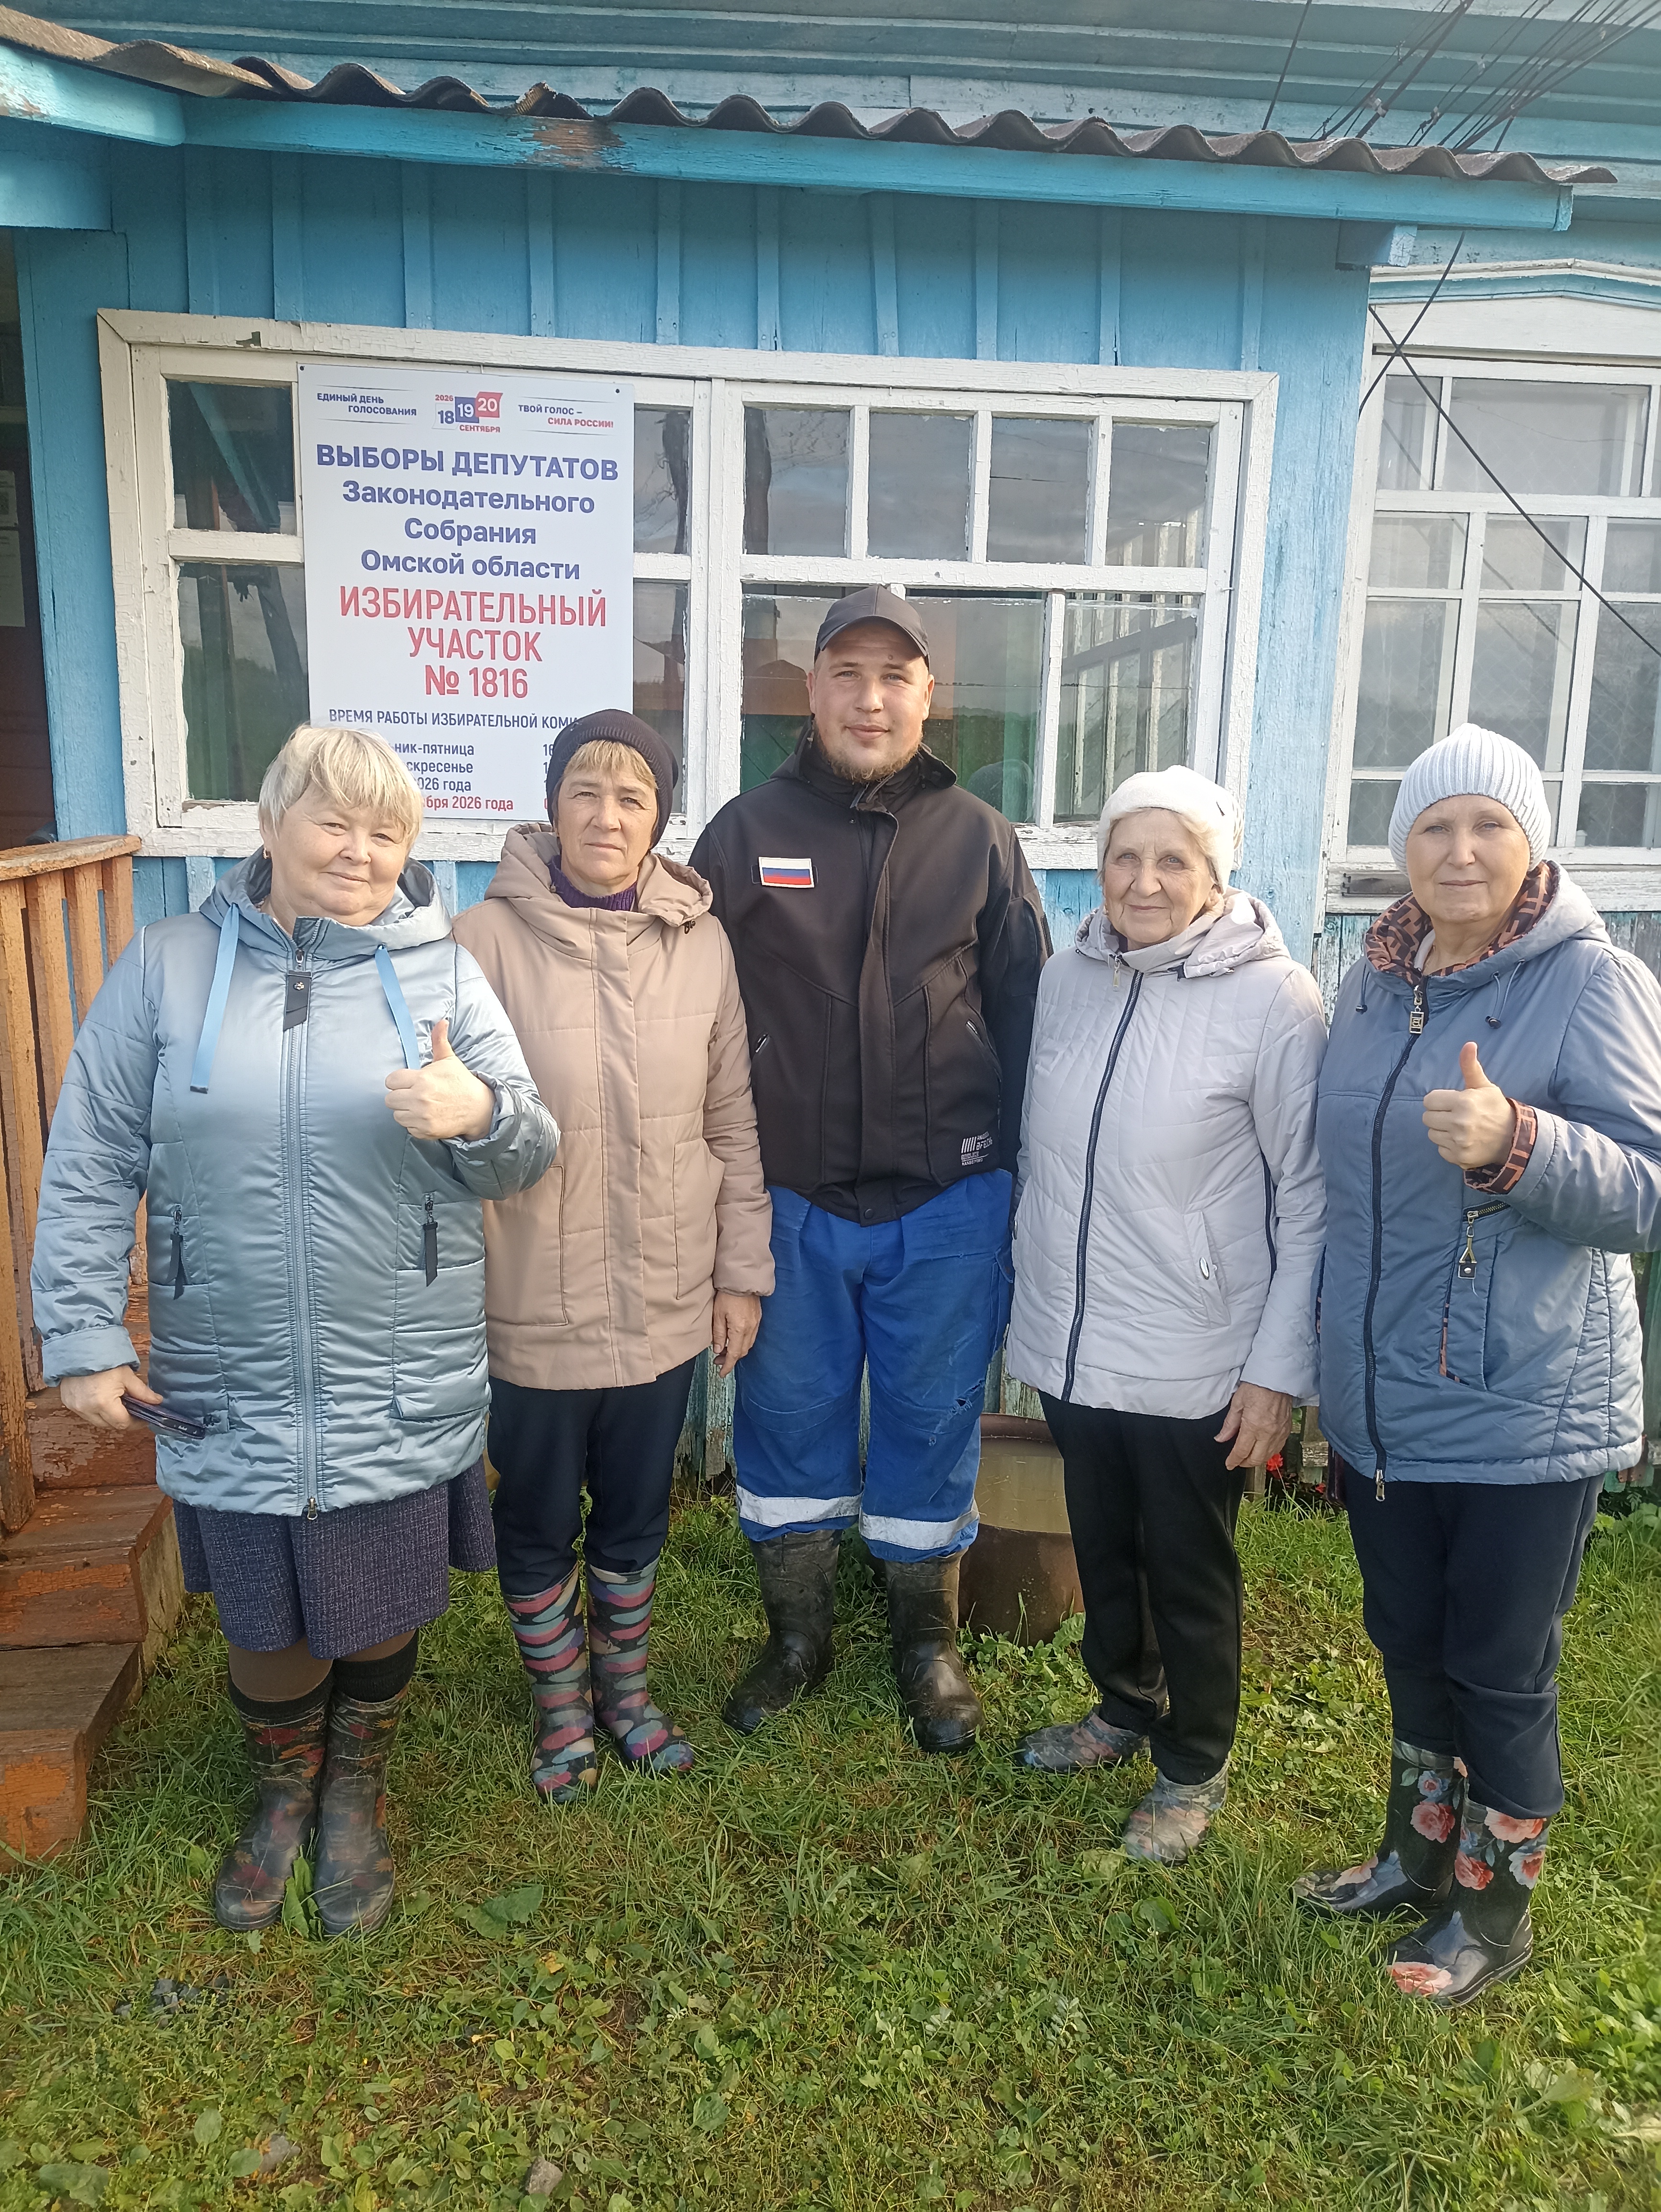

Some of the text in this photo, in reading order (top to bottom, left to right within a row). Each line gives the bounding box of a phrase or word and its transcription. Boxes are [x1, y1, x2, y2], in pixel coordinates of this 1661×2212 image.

[317, 393, 384, 404] ЕДИНЫЙ ДЕНЬ
[349, 406, 416, 416] ГОЛОСОВАНИЯ
[438, 398, 498, 424] 18 19 20
[519, 404, 542, 412] ТВОЙ
[545, 407, 574, 415] ГОЛОС
[575, 419, 613, 428] РОССИИ!
[317, 444, 618, 480] ВЫБОРЫ ДЕПУТАТОВ
[343, 480, 596, 513] Законодательного
[405, 518, 535, 546] Собрания
[361, 550, 579, 579] Омской области
[341, 586, 605, 627] ИЗБИРАТЕЛЬНЫЙ
[408, 627, 543, 662] УЧАСТОК
[425, 665, 527, 698] № 1816
[330, 709, 372, 723] ВРЕМЯ
[377, 711, 427, 724] РАБОТЫ
[432, 713, 537, 728] ИЗБИРАТЕЛЬНОЙ
[392, 743, 474, 756] ник-пятница
[407, 762, 473, 774] скресенье
[417, 777, 471, 792] 026 года
[423, 795, 513, 811] бря 2026 года
